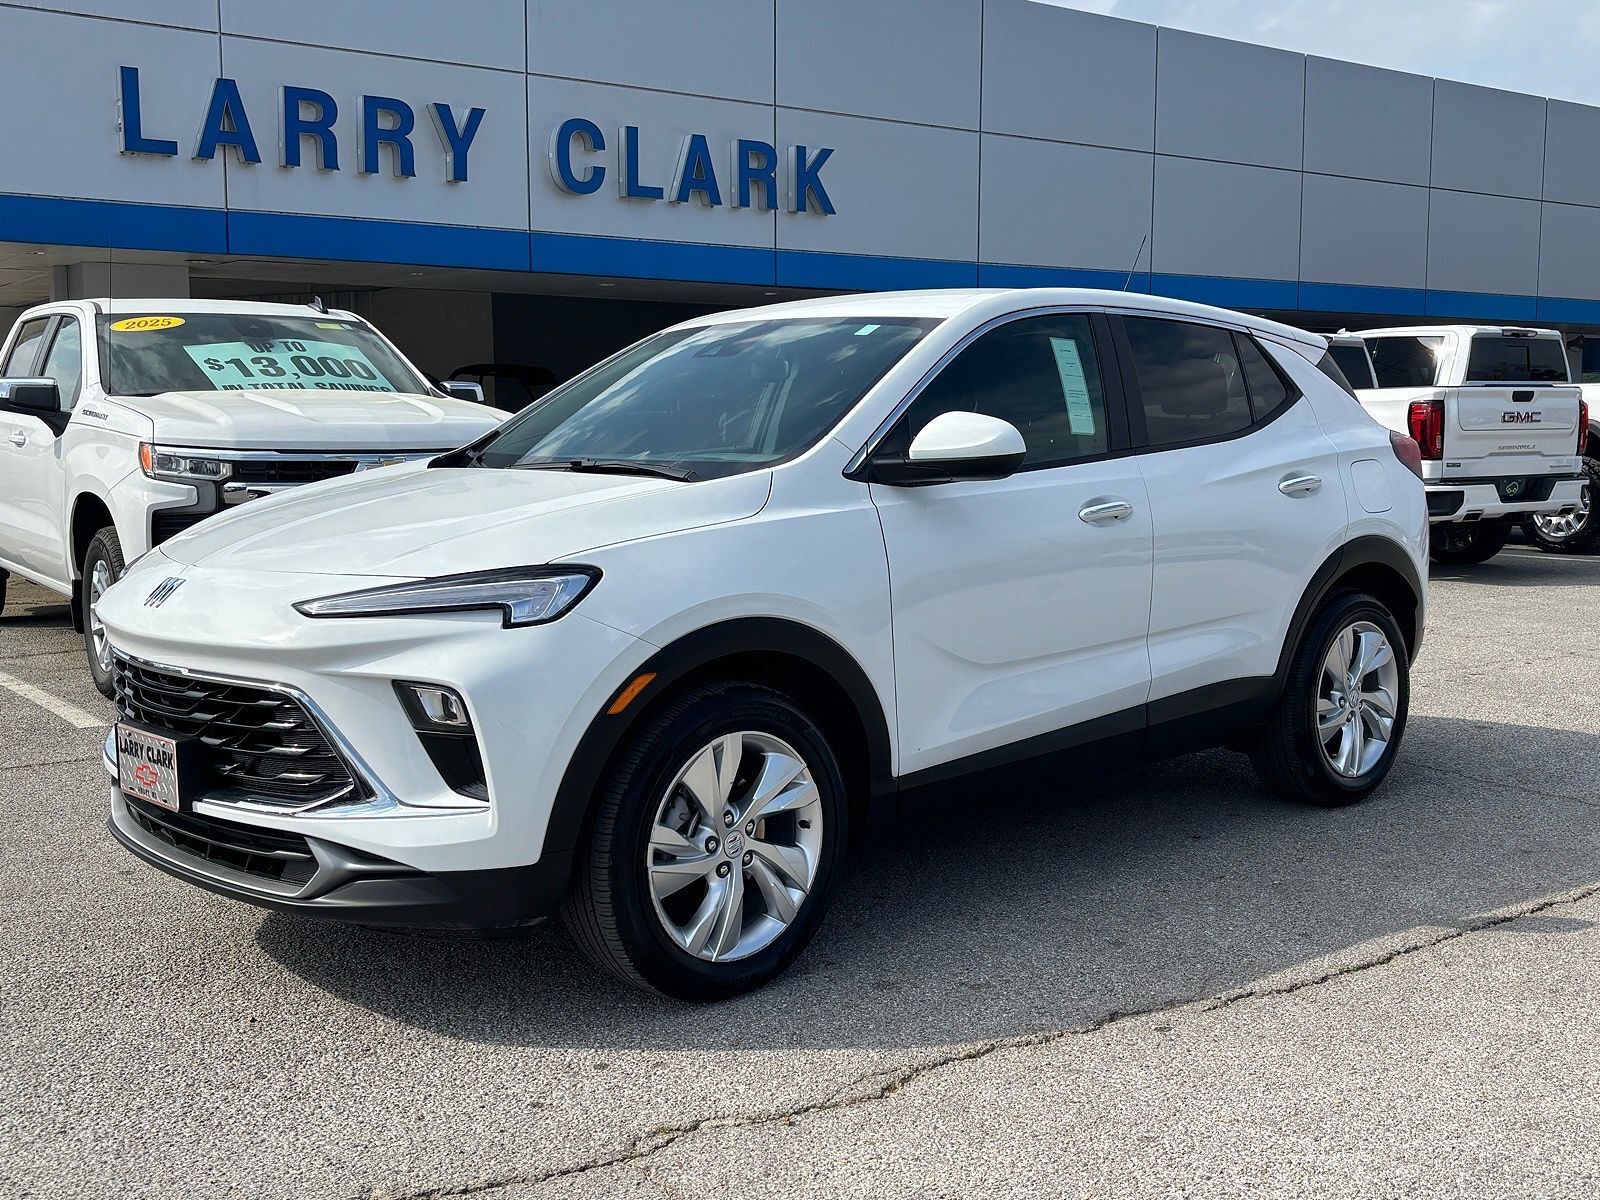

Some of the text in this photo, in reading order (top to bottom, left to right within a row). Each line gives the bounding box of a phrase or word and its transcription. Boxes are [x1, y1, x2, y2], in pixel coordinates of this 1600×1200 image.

[117, 65, 837, 216] LARRY CLARK
[125, 318, 172, 330] 2025
[247, 341, 307, 353] UP TO
[203, 355, 378, 381] $13,000
[1501, 411, 1542, 423] GMC
[119, 736, 174, 770] LARRY CLARK
